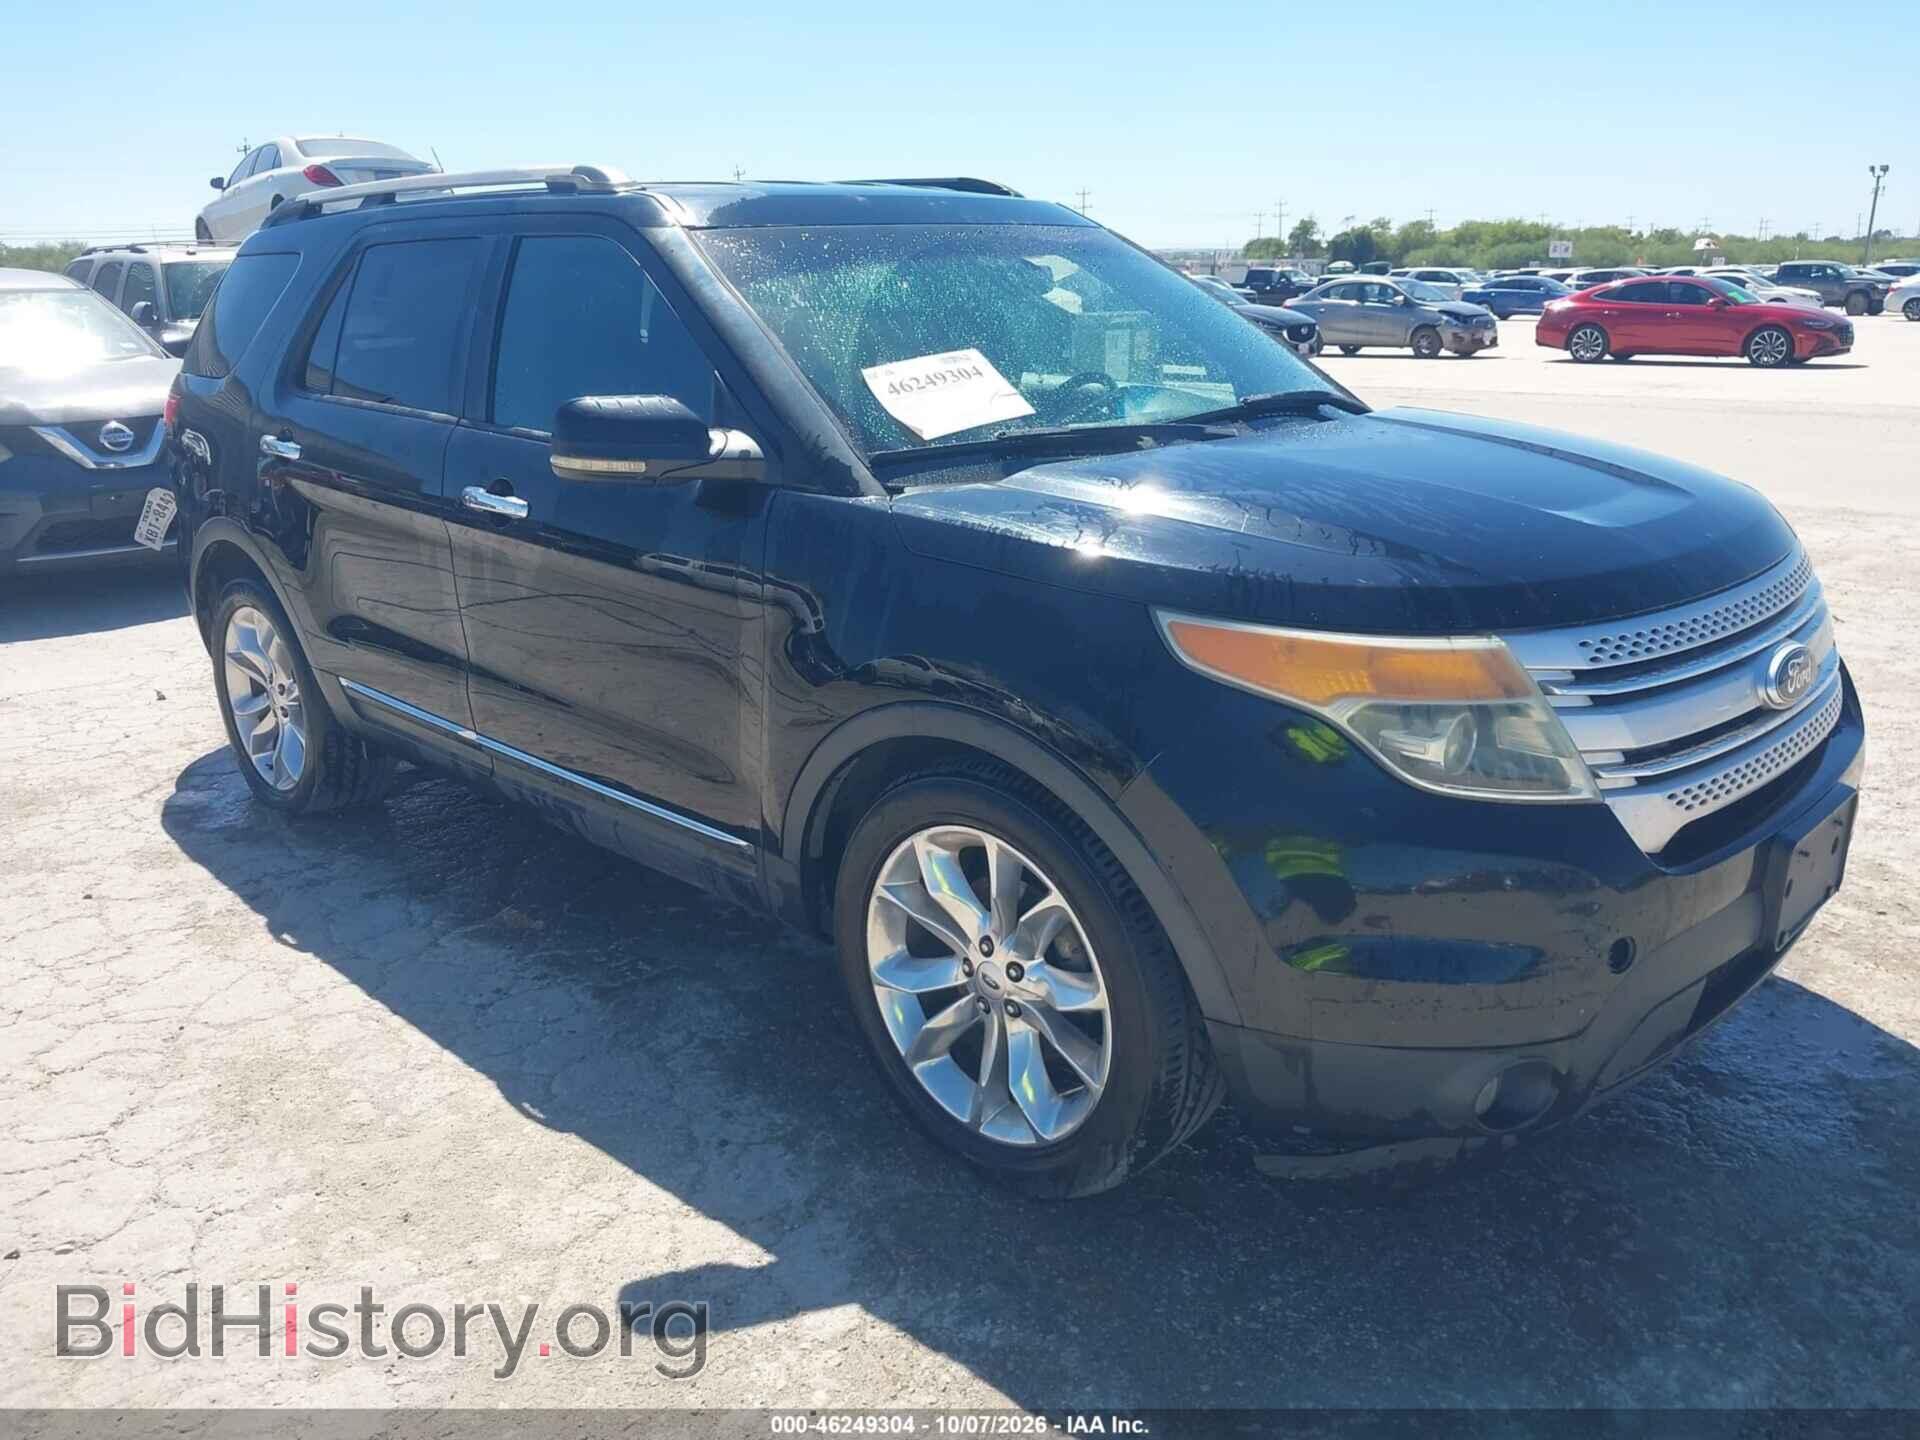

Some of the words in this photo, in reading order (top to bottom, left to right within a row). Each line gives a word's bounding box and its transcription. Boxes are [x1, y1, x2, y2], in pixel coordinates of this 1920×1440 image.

[888, 366, 983, 397] 46249304
[143, 500, 154, 522] TEXAS
[1787, 656, 1810, 693] Ford
